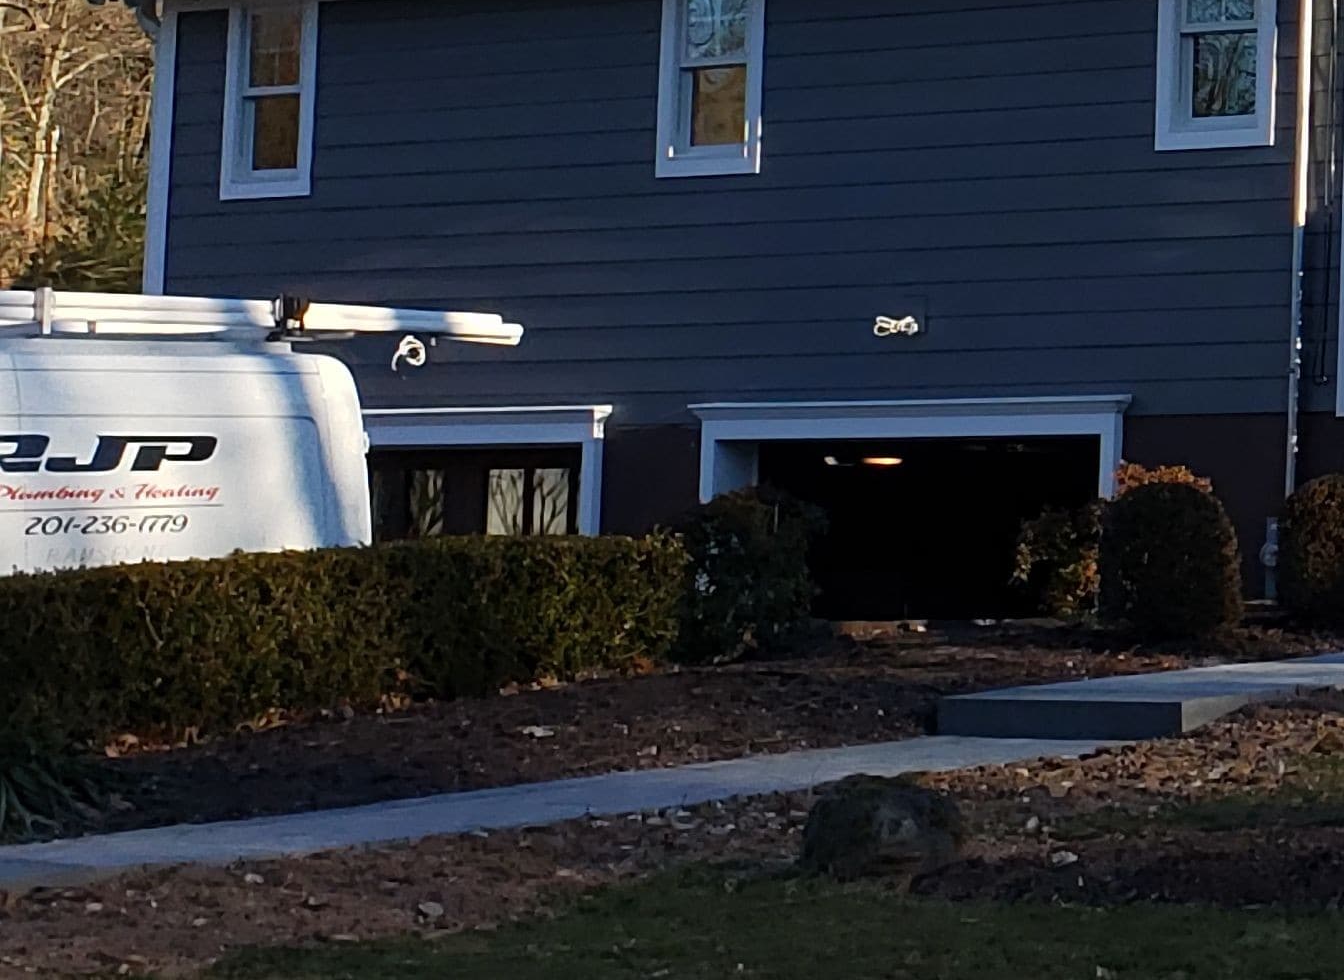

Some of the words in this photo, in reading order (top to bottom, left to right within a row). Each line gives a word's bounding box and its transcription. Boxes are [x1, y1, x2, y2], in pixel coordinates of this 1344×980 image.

[0, 484, 104, 503] Plumbing
[134, 483, 220, 502] Heating
[25, 515, 188, 535] 201-236-1779
